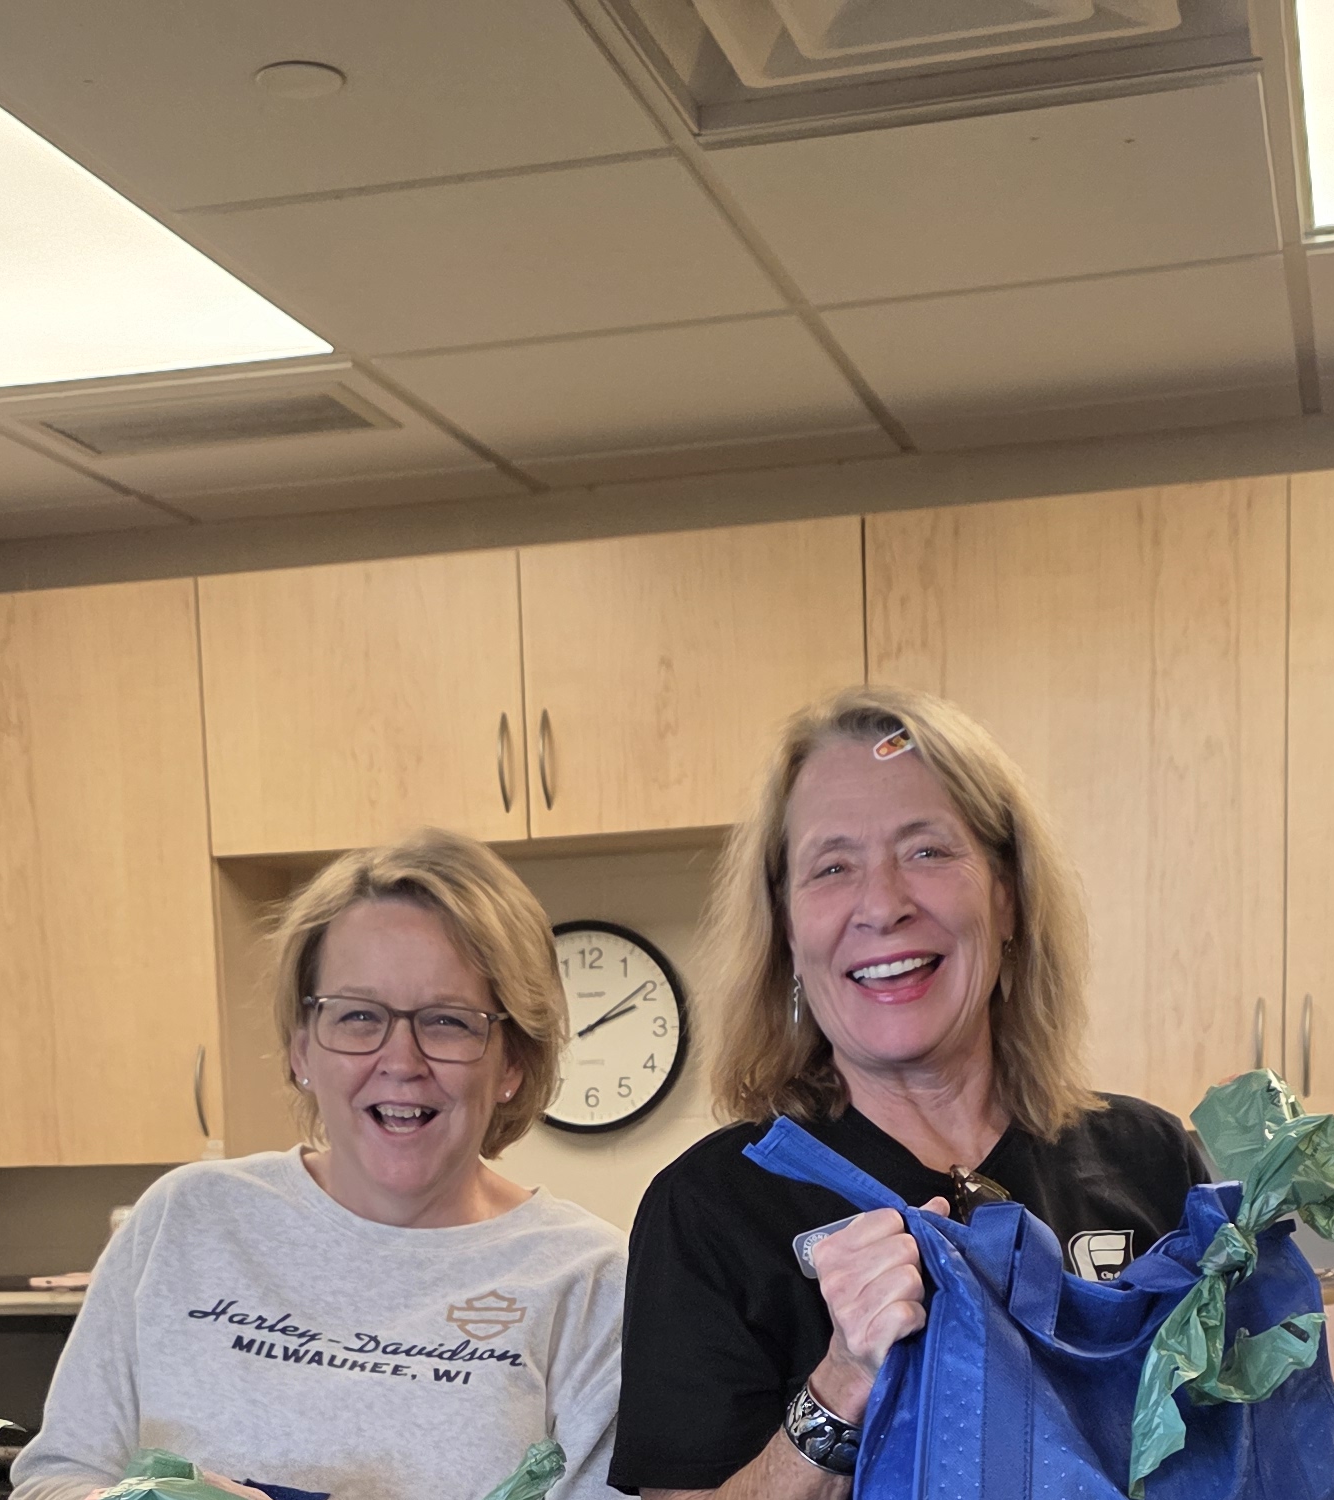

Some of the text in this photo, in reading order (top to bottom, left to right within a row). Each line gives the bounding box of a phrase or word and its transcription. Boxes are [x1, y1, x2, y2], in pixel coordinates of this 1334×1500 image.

[578, 946, 604, 970] 12
[619, 956, 628, 979] 1
[642, 980, 658, 1002] 2
[652, 1016, 668, 1038] 3
[642, 1053, 658, 1074] 4
[584, 1087, 600, 1108] 6
[617, 1077, 632, 1098] 5
[187, 1298, 525, 1368] Harley-Davidson
[231, 1335, 472, 1385] MILWAUKEE, WI
